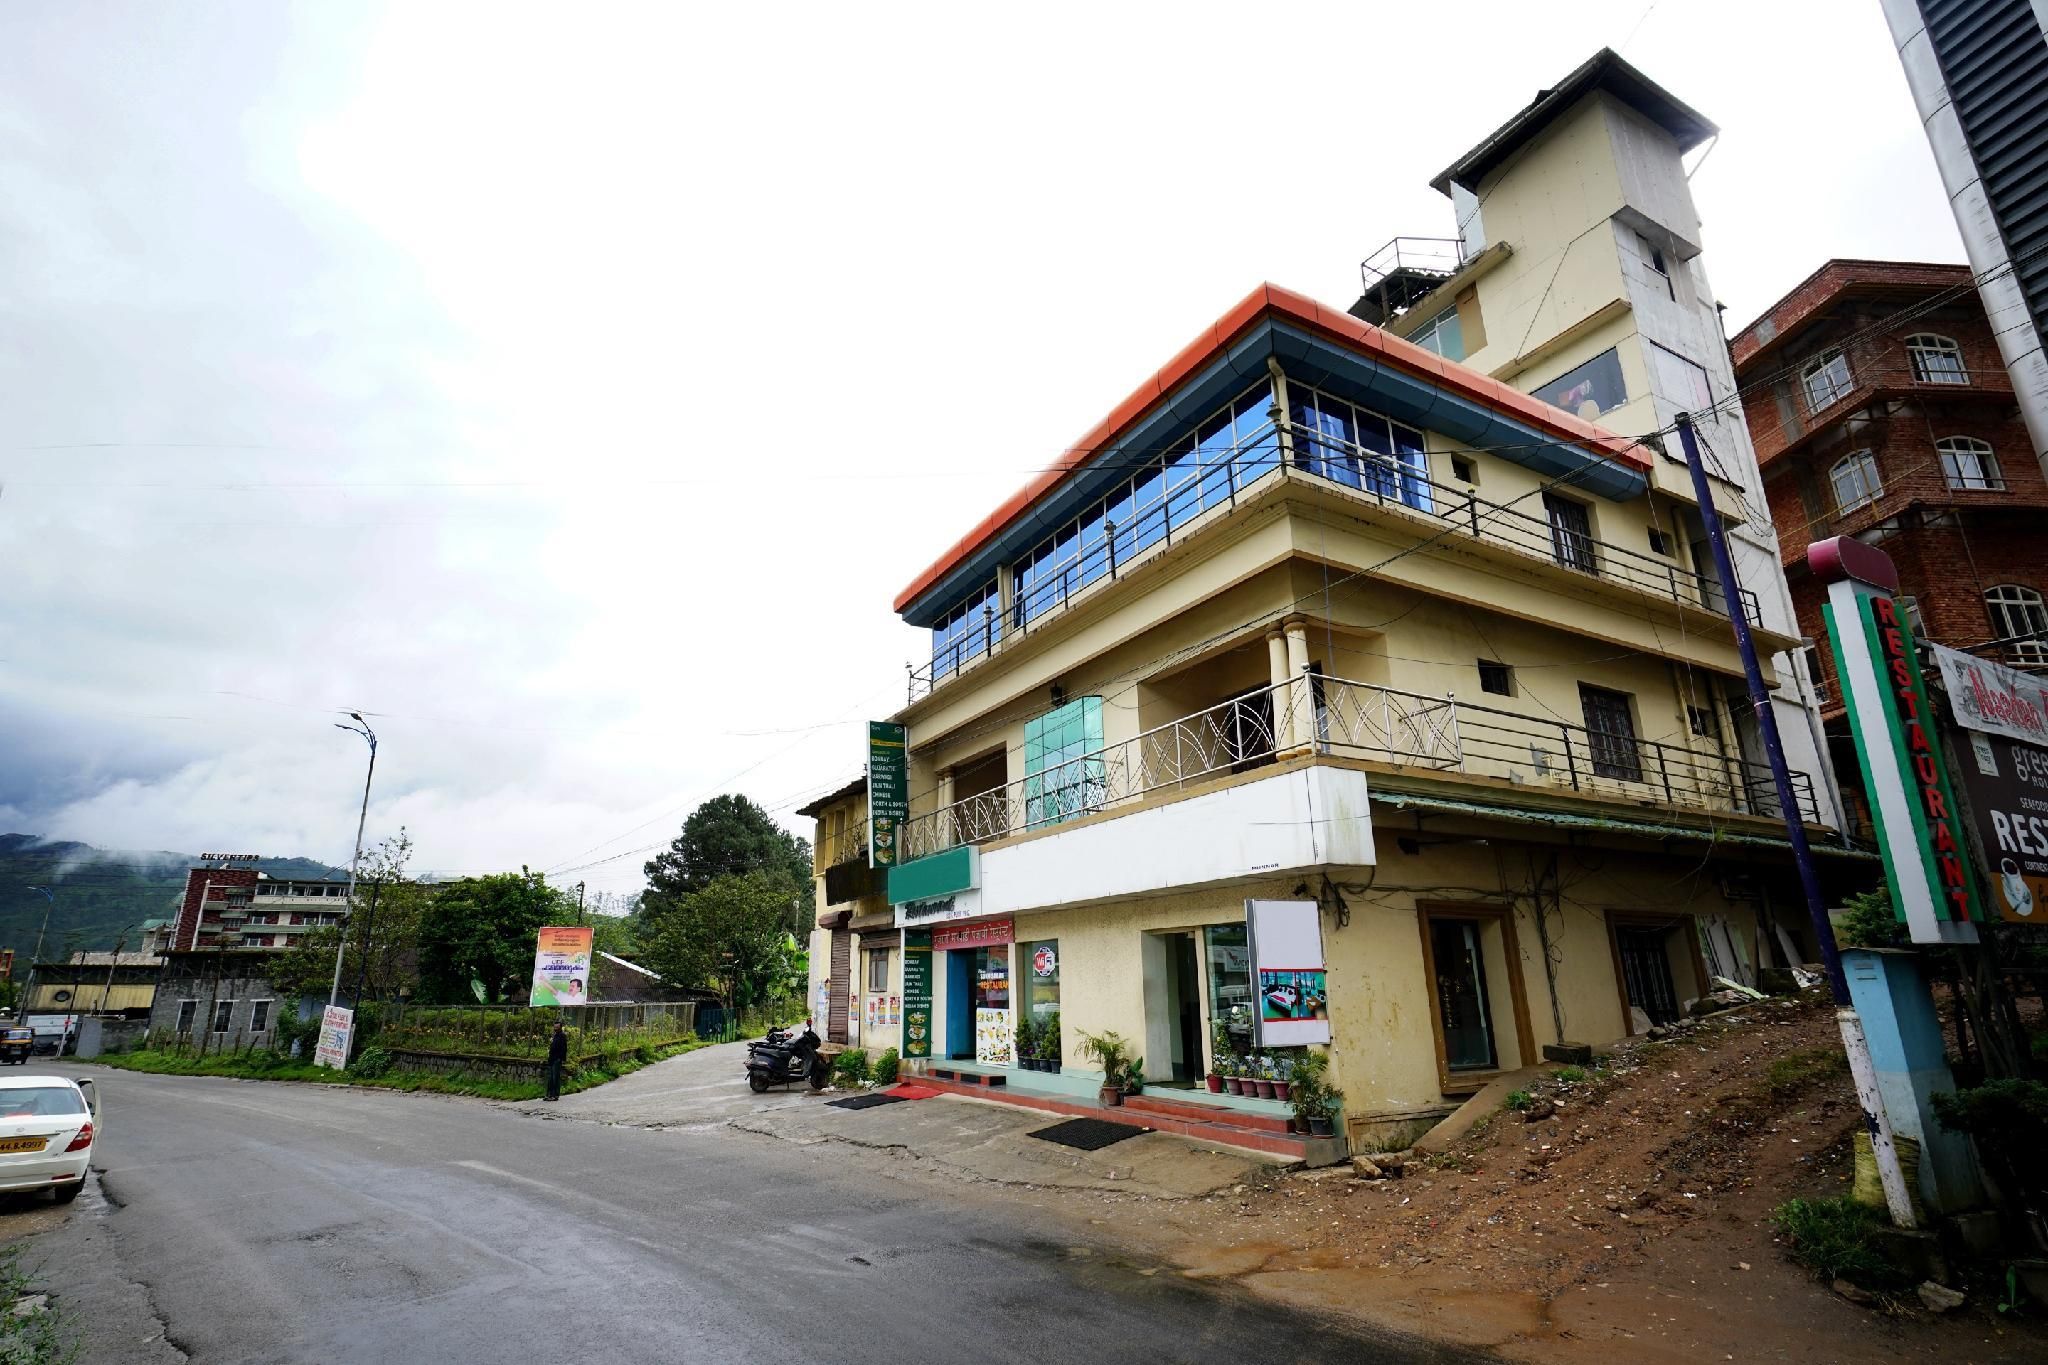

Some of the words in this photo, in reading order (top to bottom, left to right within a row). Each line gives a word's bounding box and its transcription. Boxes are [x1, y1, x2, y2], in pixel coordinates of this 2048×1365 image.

[1876, 598, 1969, 922] RESTAURANT
[201, 853, 260, 861] SILVERTIPS
[905, 896, 956, 920] Restaurant
